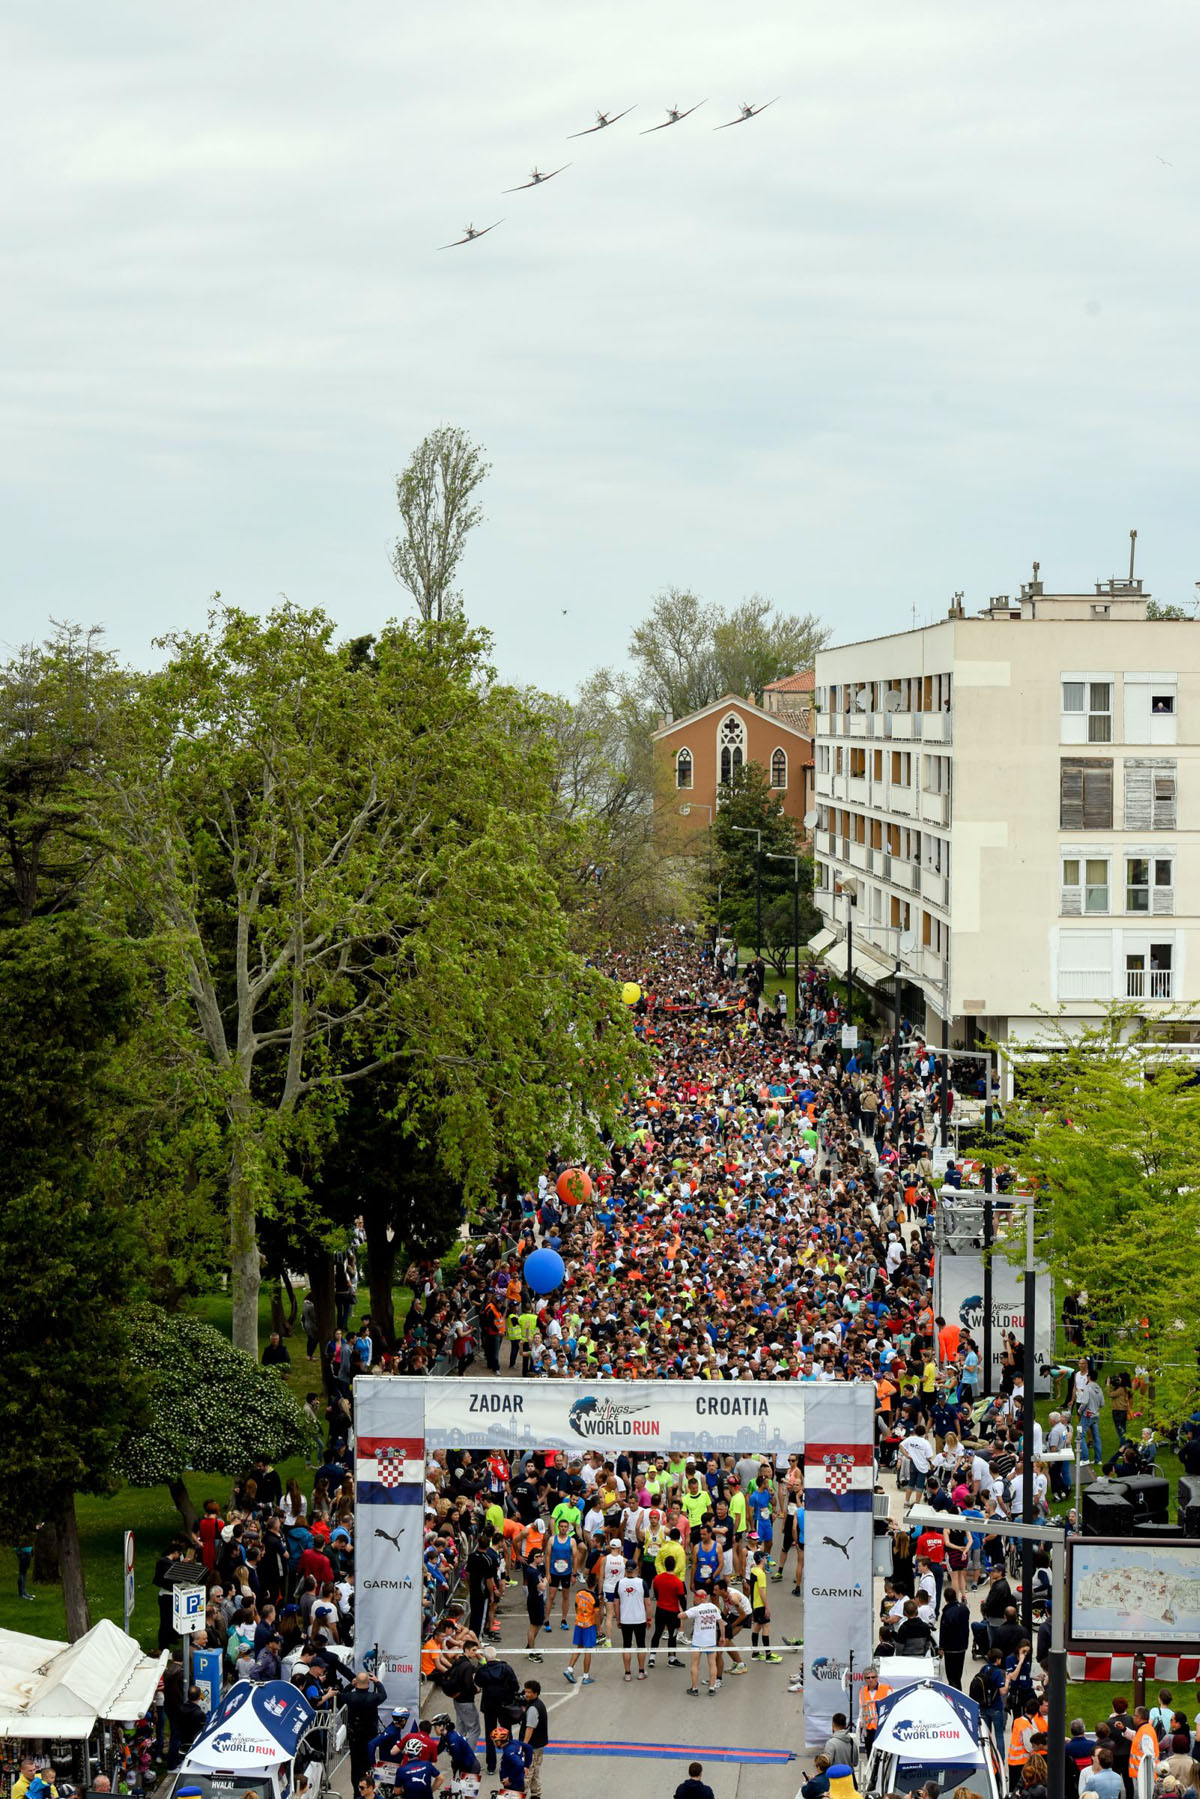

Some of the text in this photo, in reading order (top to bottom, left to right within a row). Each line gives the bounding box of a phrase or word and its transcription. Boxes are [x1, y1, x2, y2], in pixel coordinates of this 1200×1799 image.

[972, 1315, 1010, 1328] WRLD
[469, 1394, 523, 1413] ZADAR
[696, 1397, 769, 1416] CROATIA
[597, 1406, 629, 1414] WINGS
[584, 1420, 660, 1436] WORLD RUN
[363, 1580, 412, 1590] GARMIN
[811, 1587, 862, 1598] GARMIN
[189, 1597, 199, 1613] P
[200, 1658, 208, 1672] P
[397, 1664, 413, 1673] RUN
[820, 1670, 845, 1681] WORL
[903, 1730, 960, 1740] WORLD RUN
[222, 1744, 275, 1757] WORLD RUN
[211, 1781, 235, 1790] HVALA!
